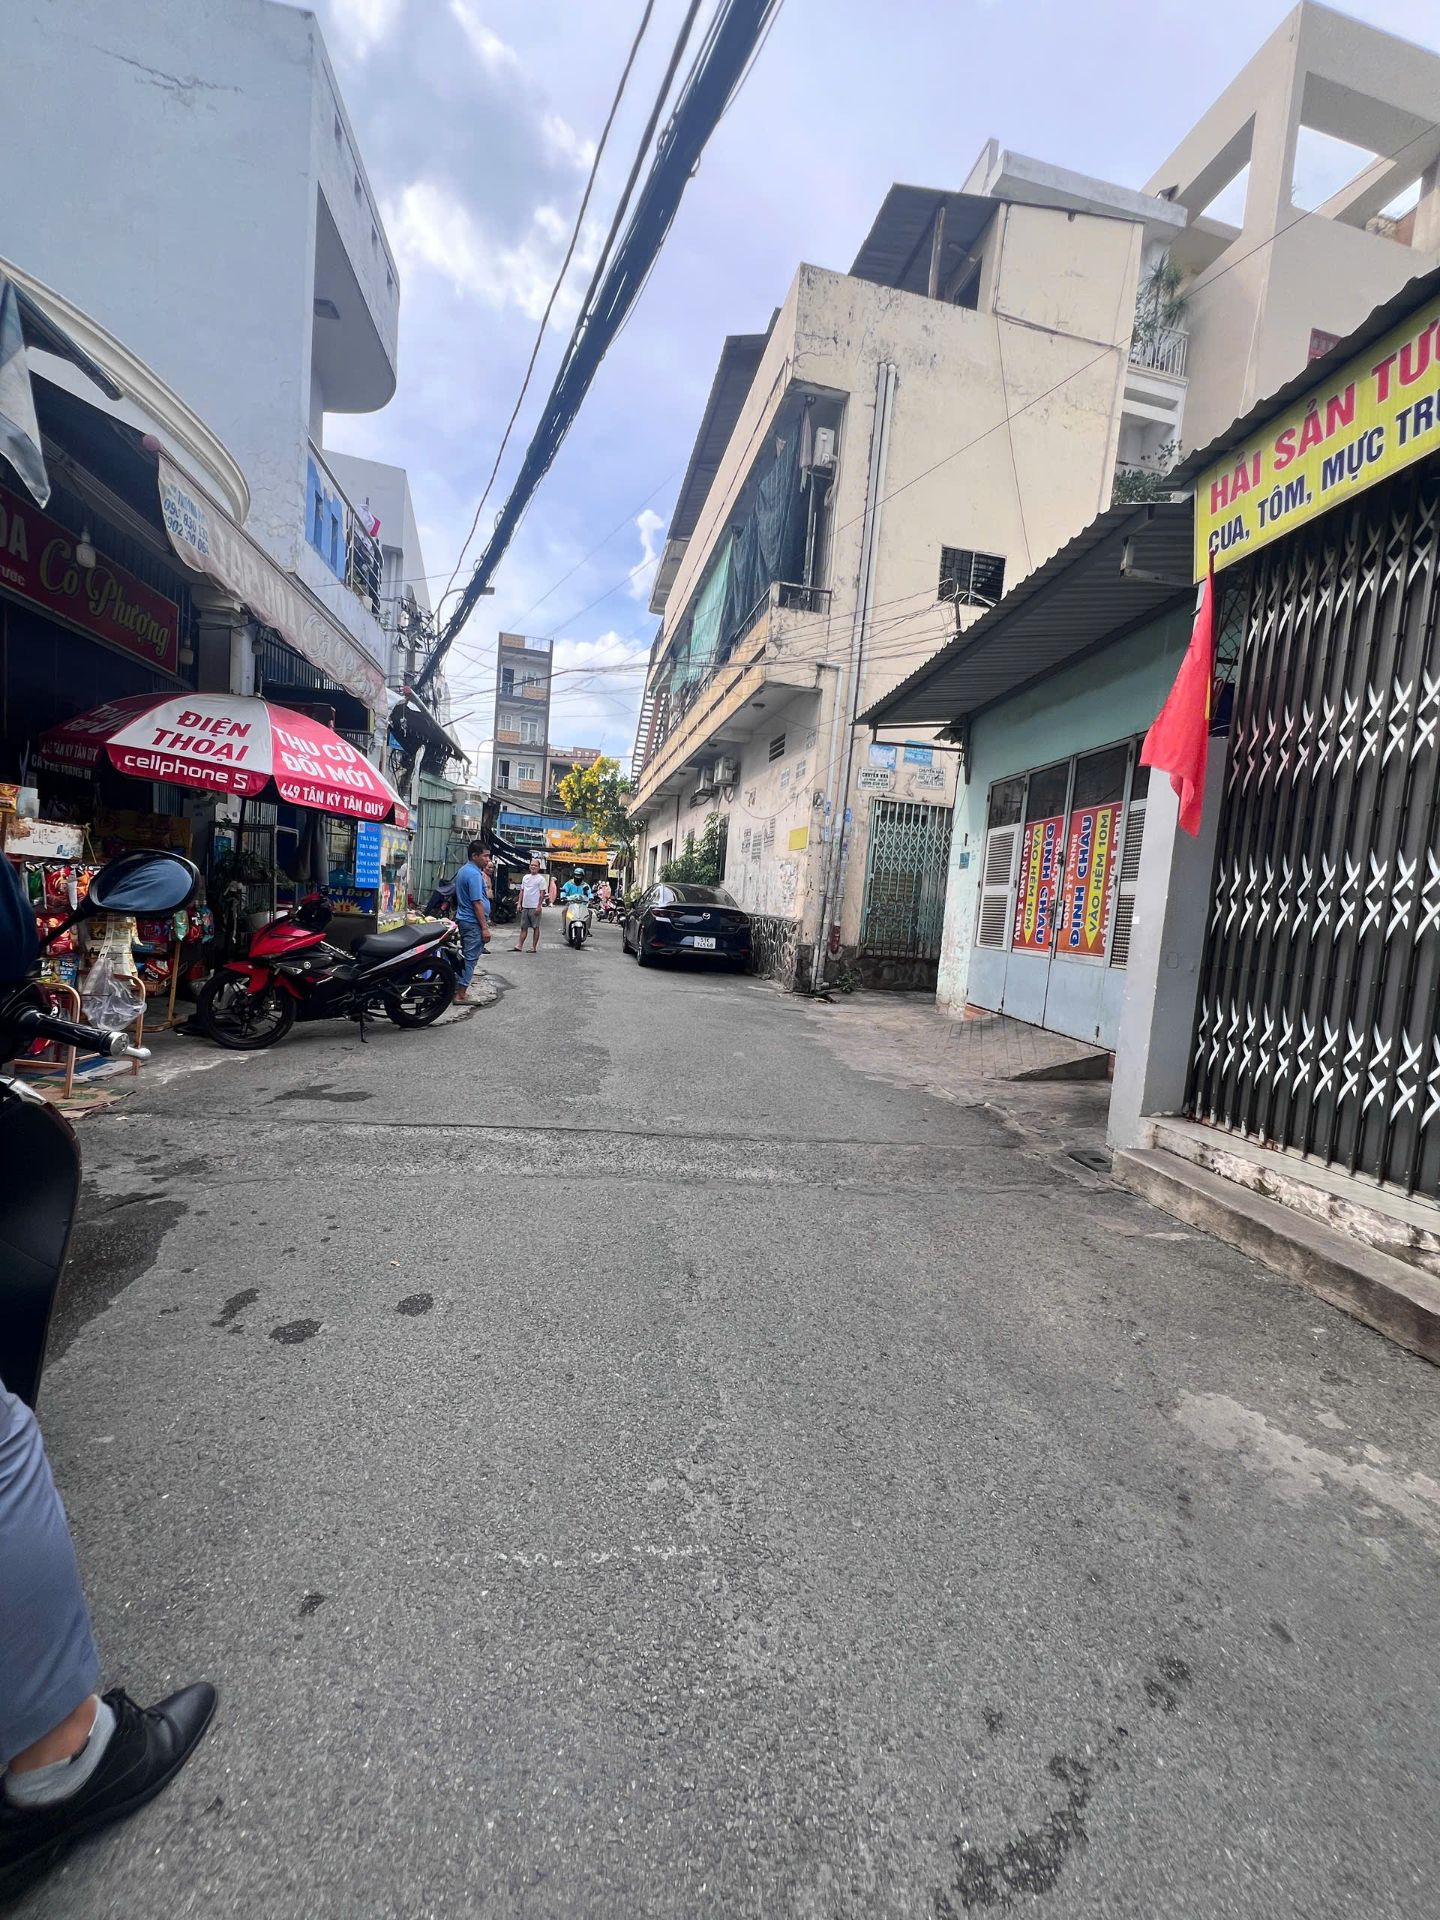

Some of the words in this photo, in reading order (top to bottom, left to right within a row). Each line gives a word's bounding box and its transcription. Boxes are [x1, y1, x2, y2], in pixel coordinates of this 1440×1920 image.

[1210, 451, 1261, 515] HẢI
[1274, 383, 1356, 471] SẢN
[1371, 318, 1440, 404] TƯ
[1208, 515, 1250, 555] CUA,
[1258, 475, 1313, 528] TÔM,
[1321, 427, 1385, 491] MỰC
[1396, 389, 1440, 446] TR
[40, 538, 78, 597] Cô
[86, 566, 169, 658] Phượng
[177, 710, 251, 738] ĐIỆN
[152, 728, 249, 762] THOẠI
[272, 725, 321, 757] THU
[322, 741, 358, 763] CŨ
[124, 754, 229, 784] cellphone
[281, 751, 326, 779] ĐỔI
[326, 765, 375, 790] MỚI
[281, 782, 301, 799] 449
[303, 785, 325, 804] TÂN
[327, 789, 340, 807] KỲ
[343, 795, 362, 813] TÂN
[365, 802, 385, 817] QUÝ
[1031, 828, 1041, 862] VÀO
[1041, 823, 1056, 881] ĐỊNH
[1076, 815, 1093, 881] CHÂU
[1027, 865, 1038, 898] HẺM
[1093, 853, 1105, 890] HẺM
[1036, 886, 1049, 945] CHÂU
[1069, 885, 1086, 948] ĐỊNH
[1089, 896, 1100, 933] VÀO
